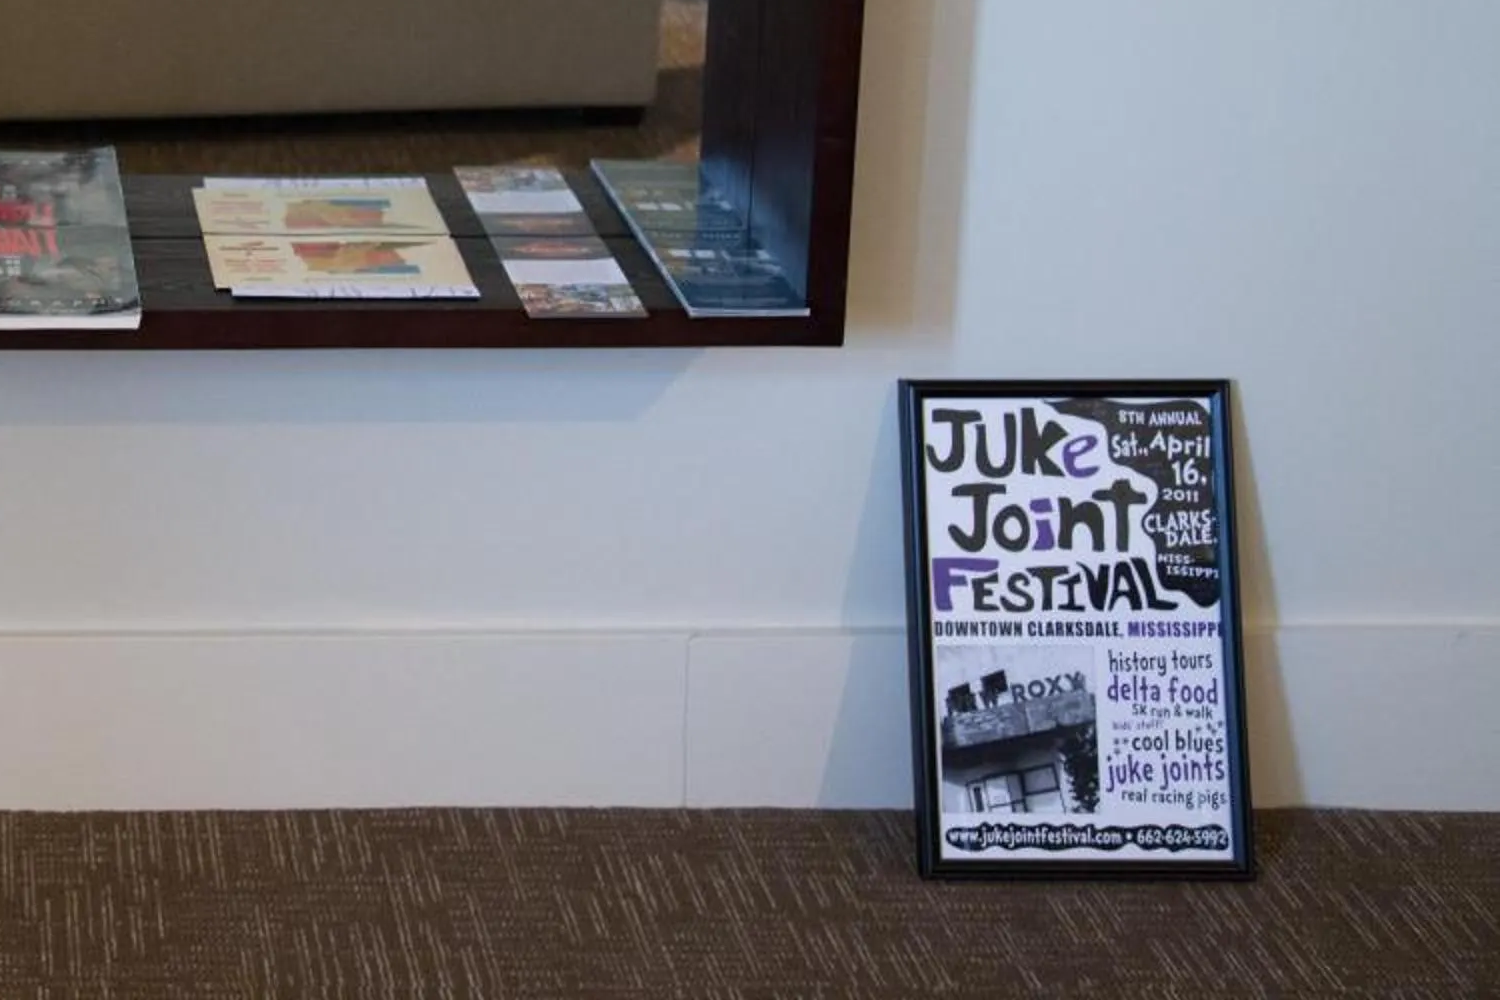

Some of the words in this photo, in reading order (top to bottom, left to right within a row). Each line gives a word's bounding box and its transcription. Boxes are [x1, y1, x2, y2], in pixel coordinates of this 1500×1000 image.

[1148, 410, 1203, 427] ANNUAL
[1150, 430, 1211, 461] April
[1161, 488, 1200, 503] 2011
[931, 556, 1179, 613] FESTIVAL
[935, 621, 1023, 638] DOWNTOWN
[1107, 648, 1168, 676] history
[1171, 649, 1213, 671] tours
[1010, 671, 1087, 703] ROXY
[1107, 673, 1161, 704] delta
[1167, 674, 1218, 705] food
[1150, 706, 1171, 719] run
[1185, 706, 1213, 720] walk
[1131, 728, 1169, 751] cool
[1174, 728, 1224, 754] blues
[1105, 753, 1154, 793] juke
[1159, 752, 1225, 791] joints
[1121, 787, 1148, 804] real
[1151, 790, 1195, 811] racing
[1196, 789, 1228, 811] pigs
[948, 825, 1122, 847] www.jukejointfestival.com
